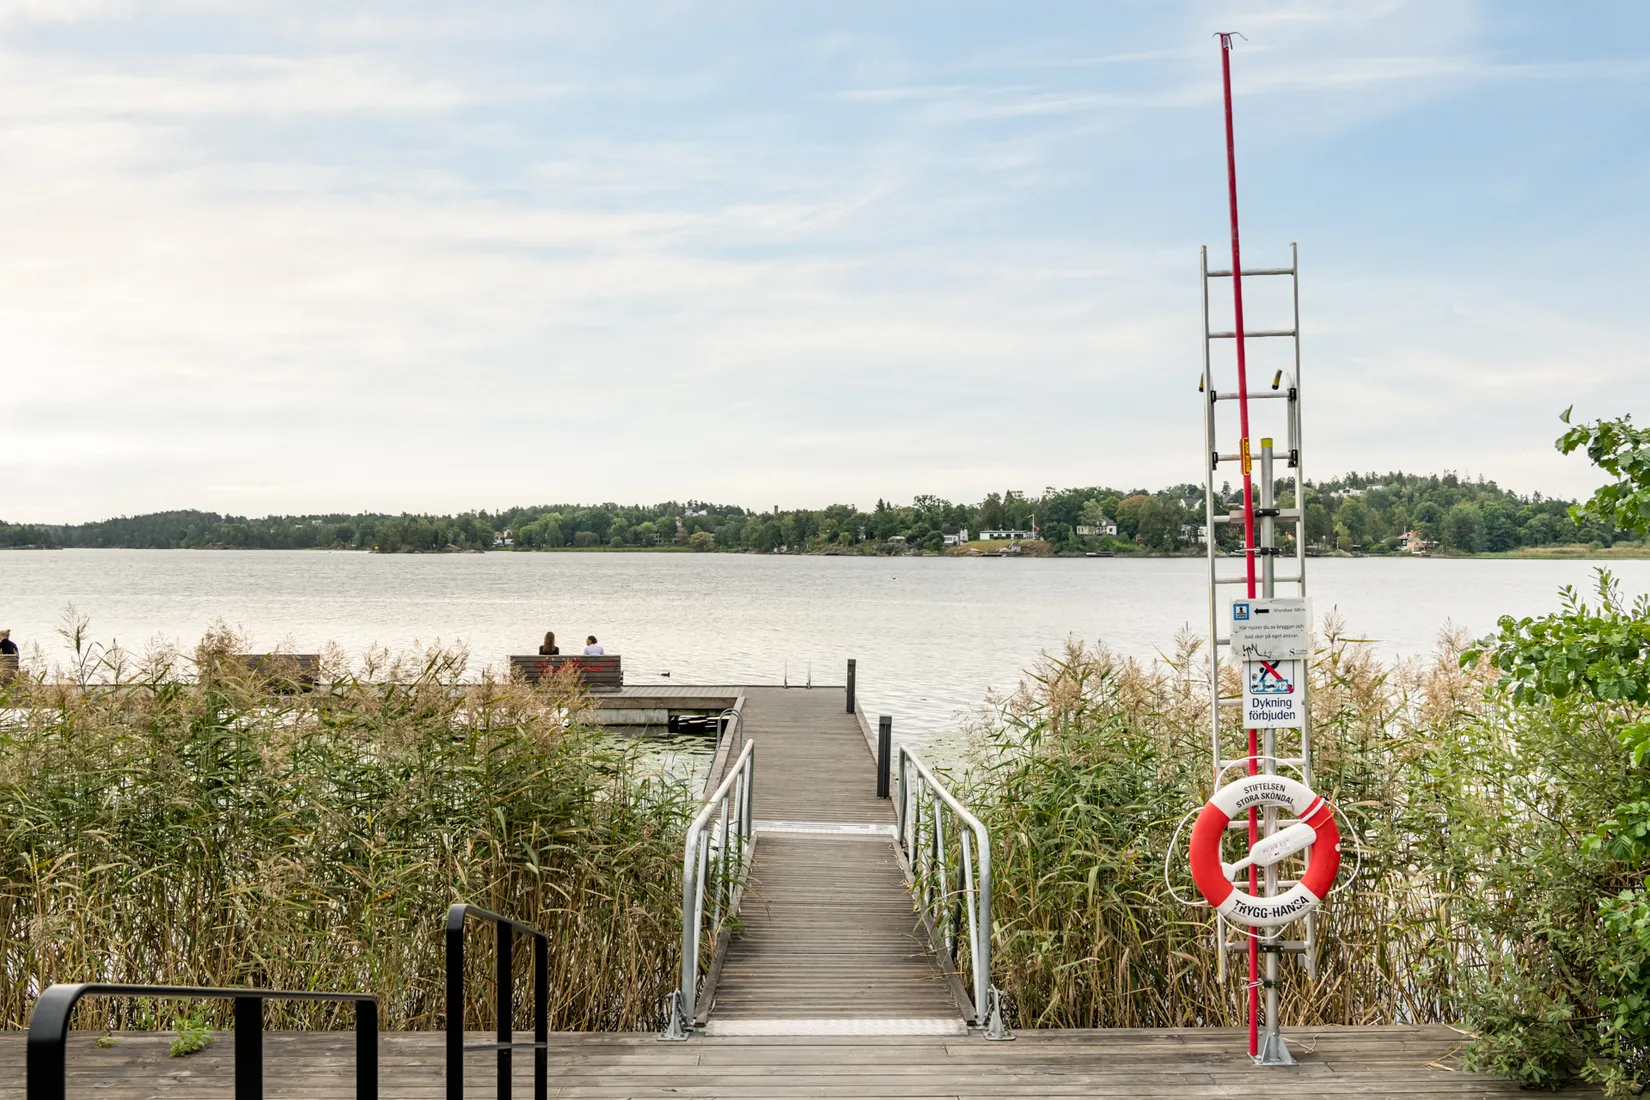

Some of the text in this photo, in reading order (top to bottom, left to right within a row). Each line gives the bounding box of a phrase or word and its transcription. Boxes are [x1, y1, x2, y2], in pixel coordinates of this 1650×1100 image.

[1252, 697, 1292, 710] Dykning
[1249, 710, 1295, 721] förbjuden
[1243, 783, 1286, 794] STIFTELSEN
[1236, 791, 1294, 808] STORA SKÖNDAL
[1233, 895, 1309, 918] TRYGG-HANSA
